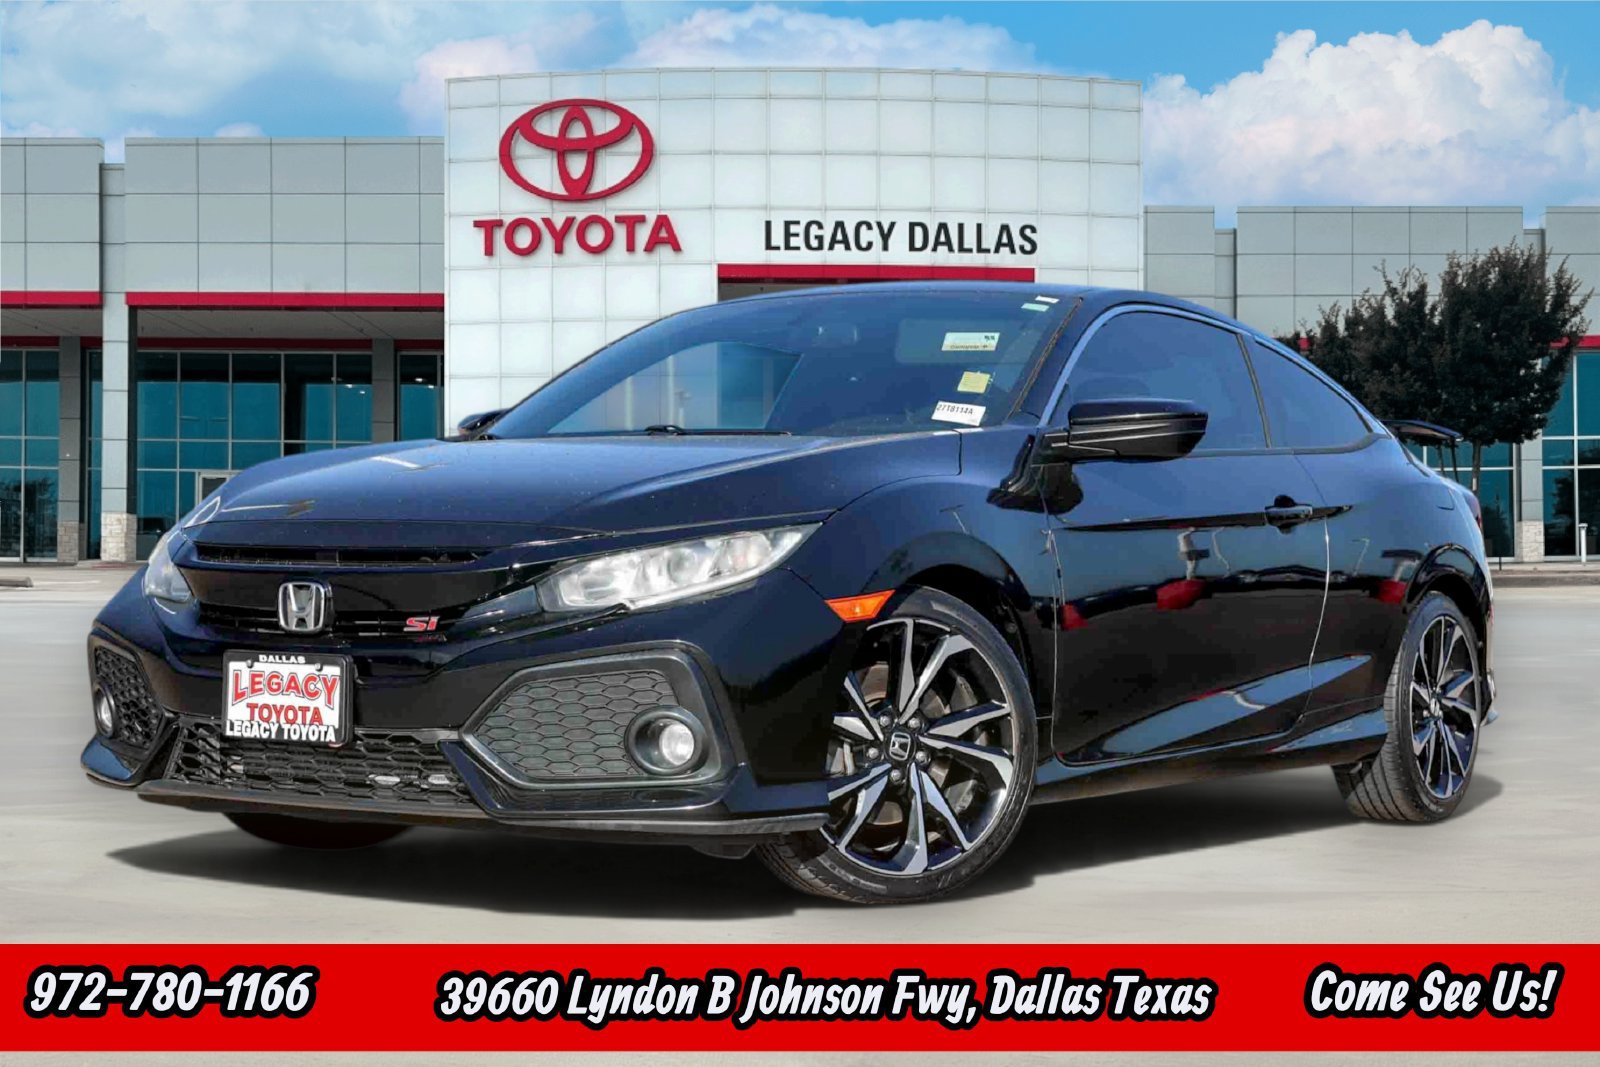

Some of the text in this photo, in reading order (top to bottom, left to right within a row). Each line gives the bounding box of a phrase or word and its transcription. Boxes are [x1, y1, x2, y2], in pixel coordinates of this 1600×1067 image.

[474, 214, 682, 257] TOYOTA
[765, 220, 1038, 255] LEGACY DALLAS
[258, 654, 306, 664] DALLAS
[231, 669, 340, 710] LEGACY
[246, 702, 323, 726] TOYOTA
[225, 720, 337, 742] LEGACY TOYOTA
